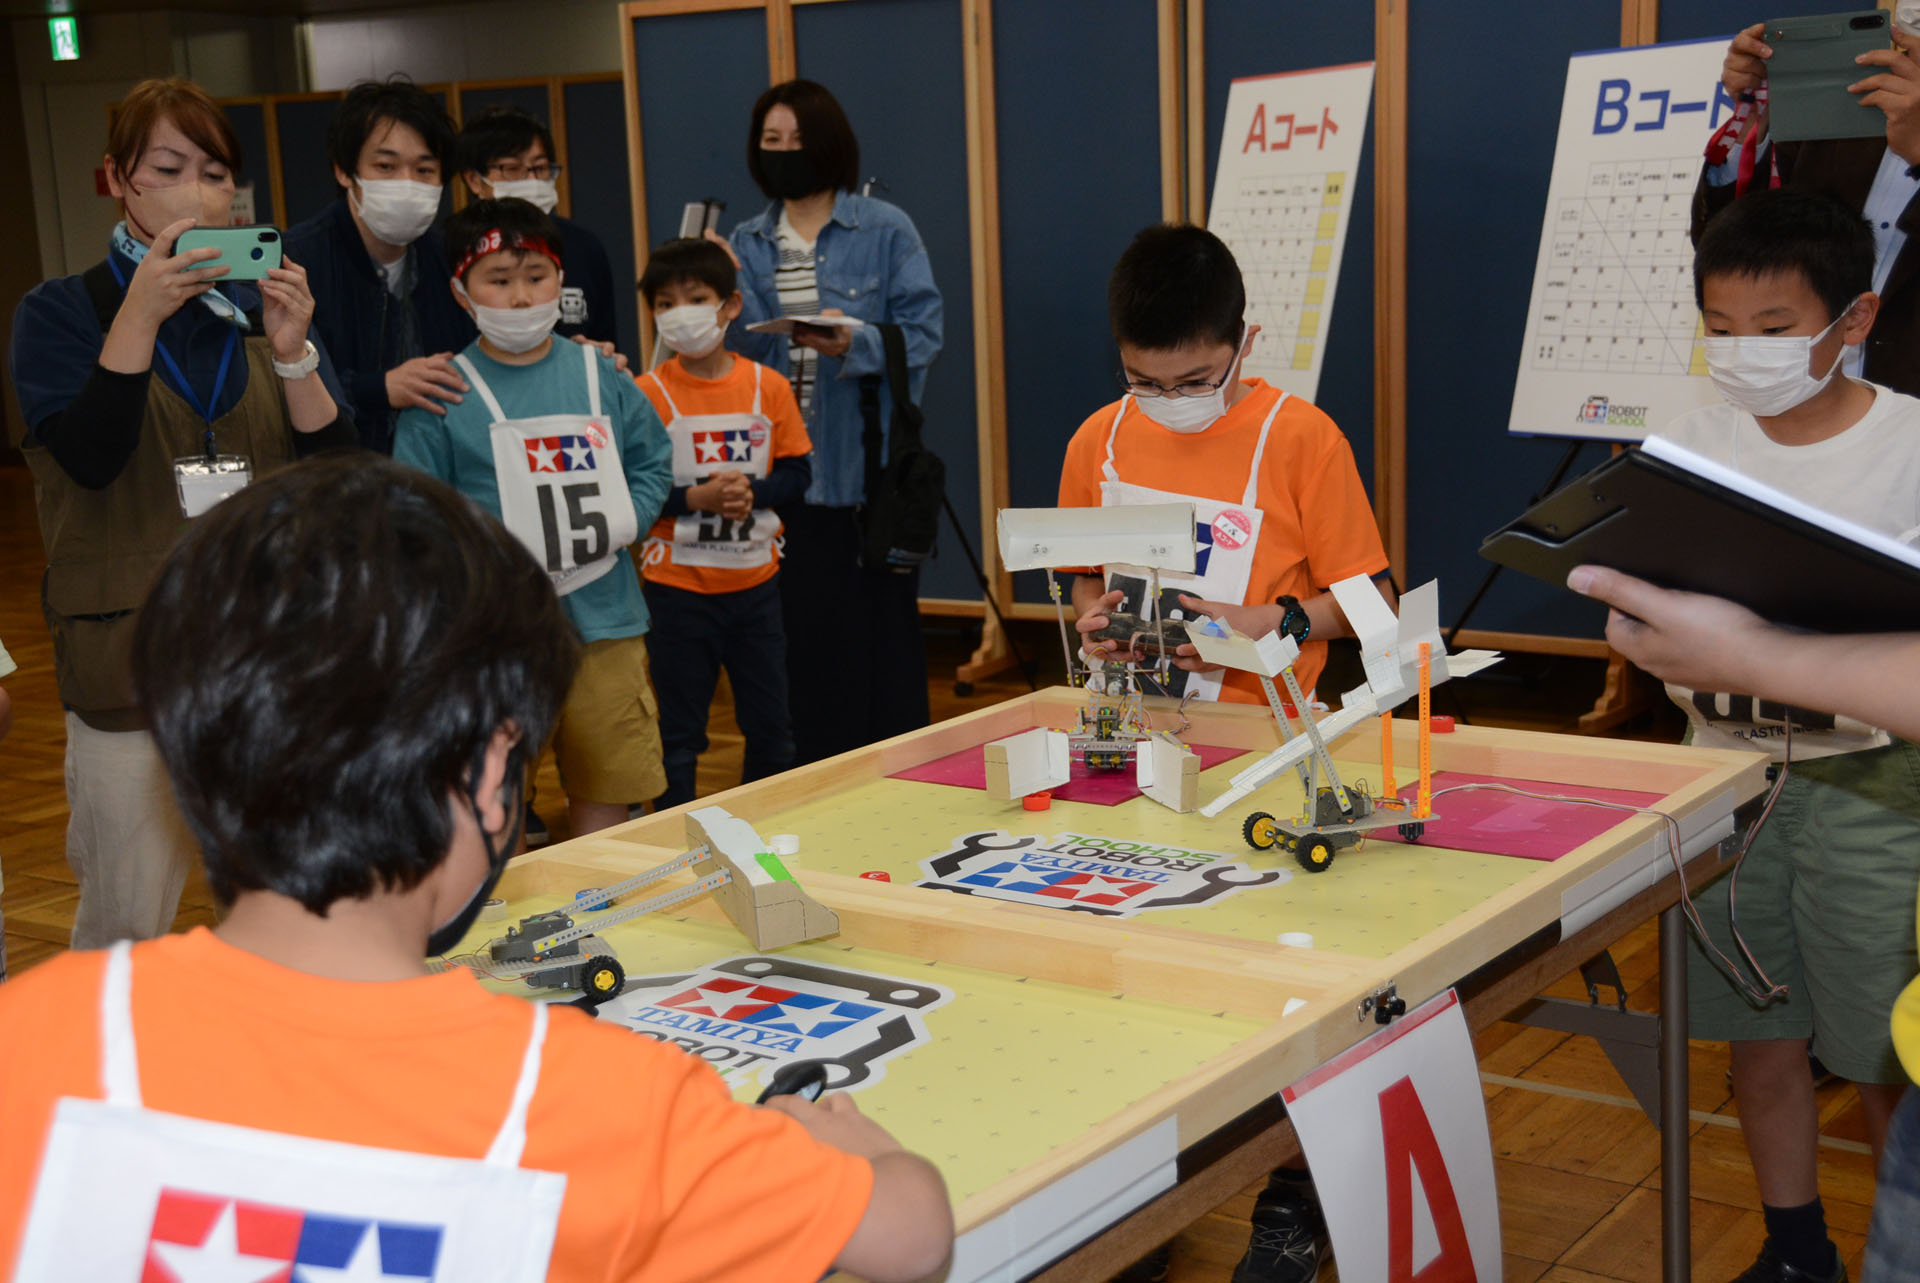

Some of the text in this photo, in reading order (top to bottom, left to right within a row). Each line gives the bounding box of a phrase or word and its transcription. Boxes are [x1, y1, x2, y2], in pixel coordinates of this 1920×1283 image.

[1242, 103, 1339, 154] Aコート
[1592, 77, 1735, 135] Bコート
[1608, 404, 1648, 417] ROBOT
[537, 482, 609, 573] 15
[1019, 852, 1176, 883] TAMIYA
[1036, 843, 1205, 872] ROBOT
[1066, 834, 1222, 863] SCHOOL
[629, 1006, 804, 1053] TAMIYA
[1377, 1074, 1479, 1283] A
